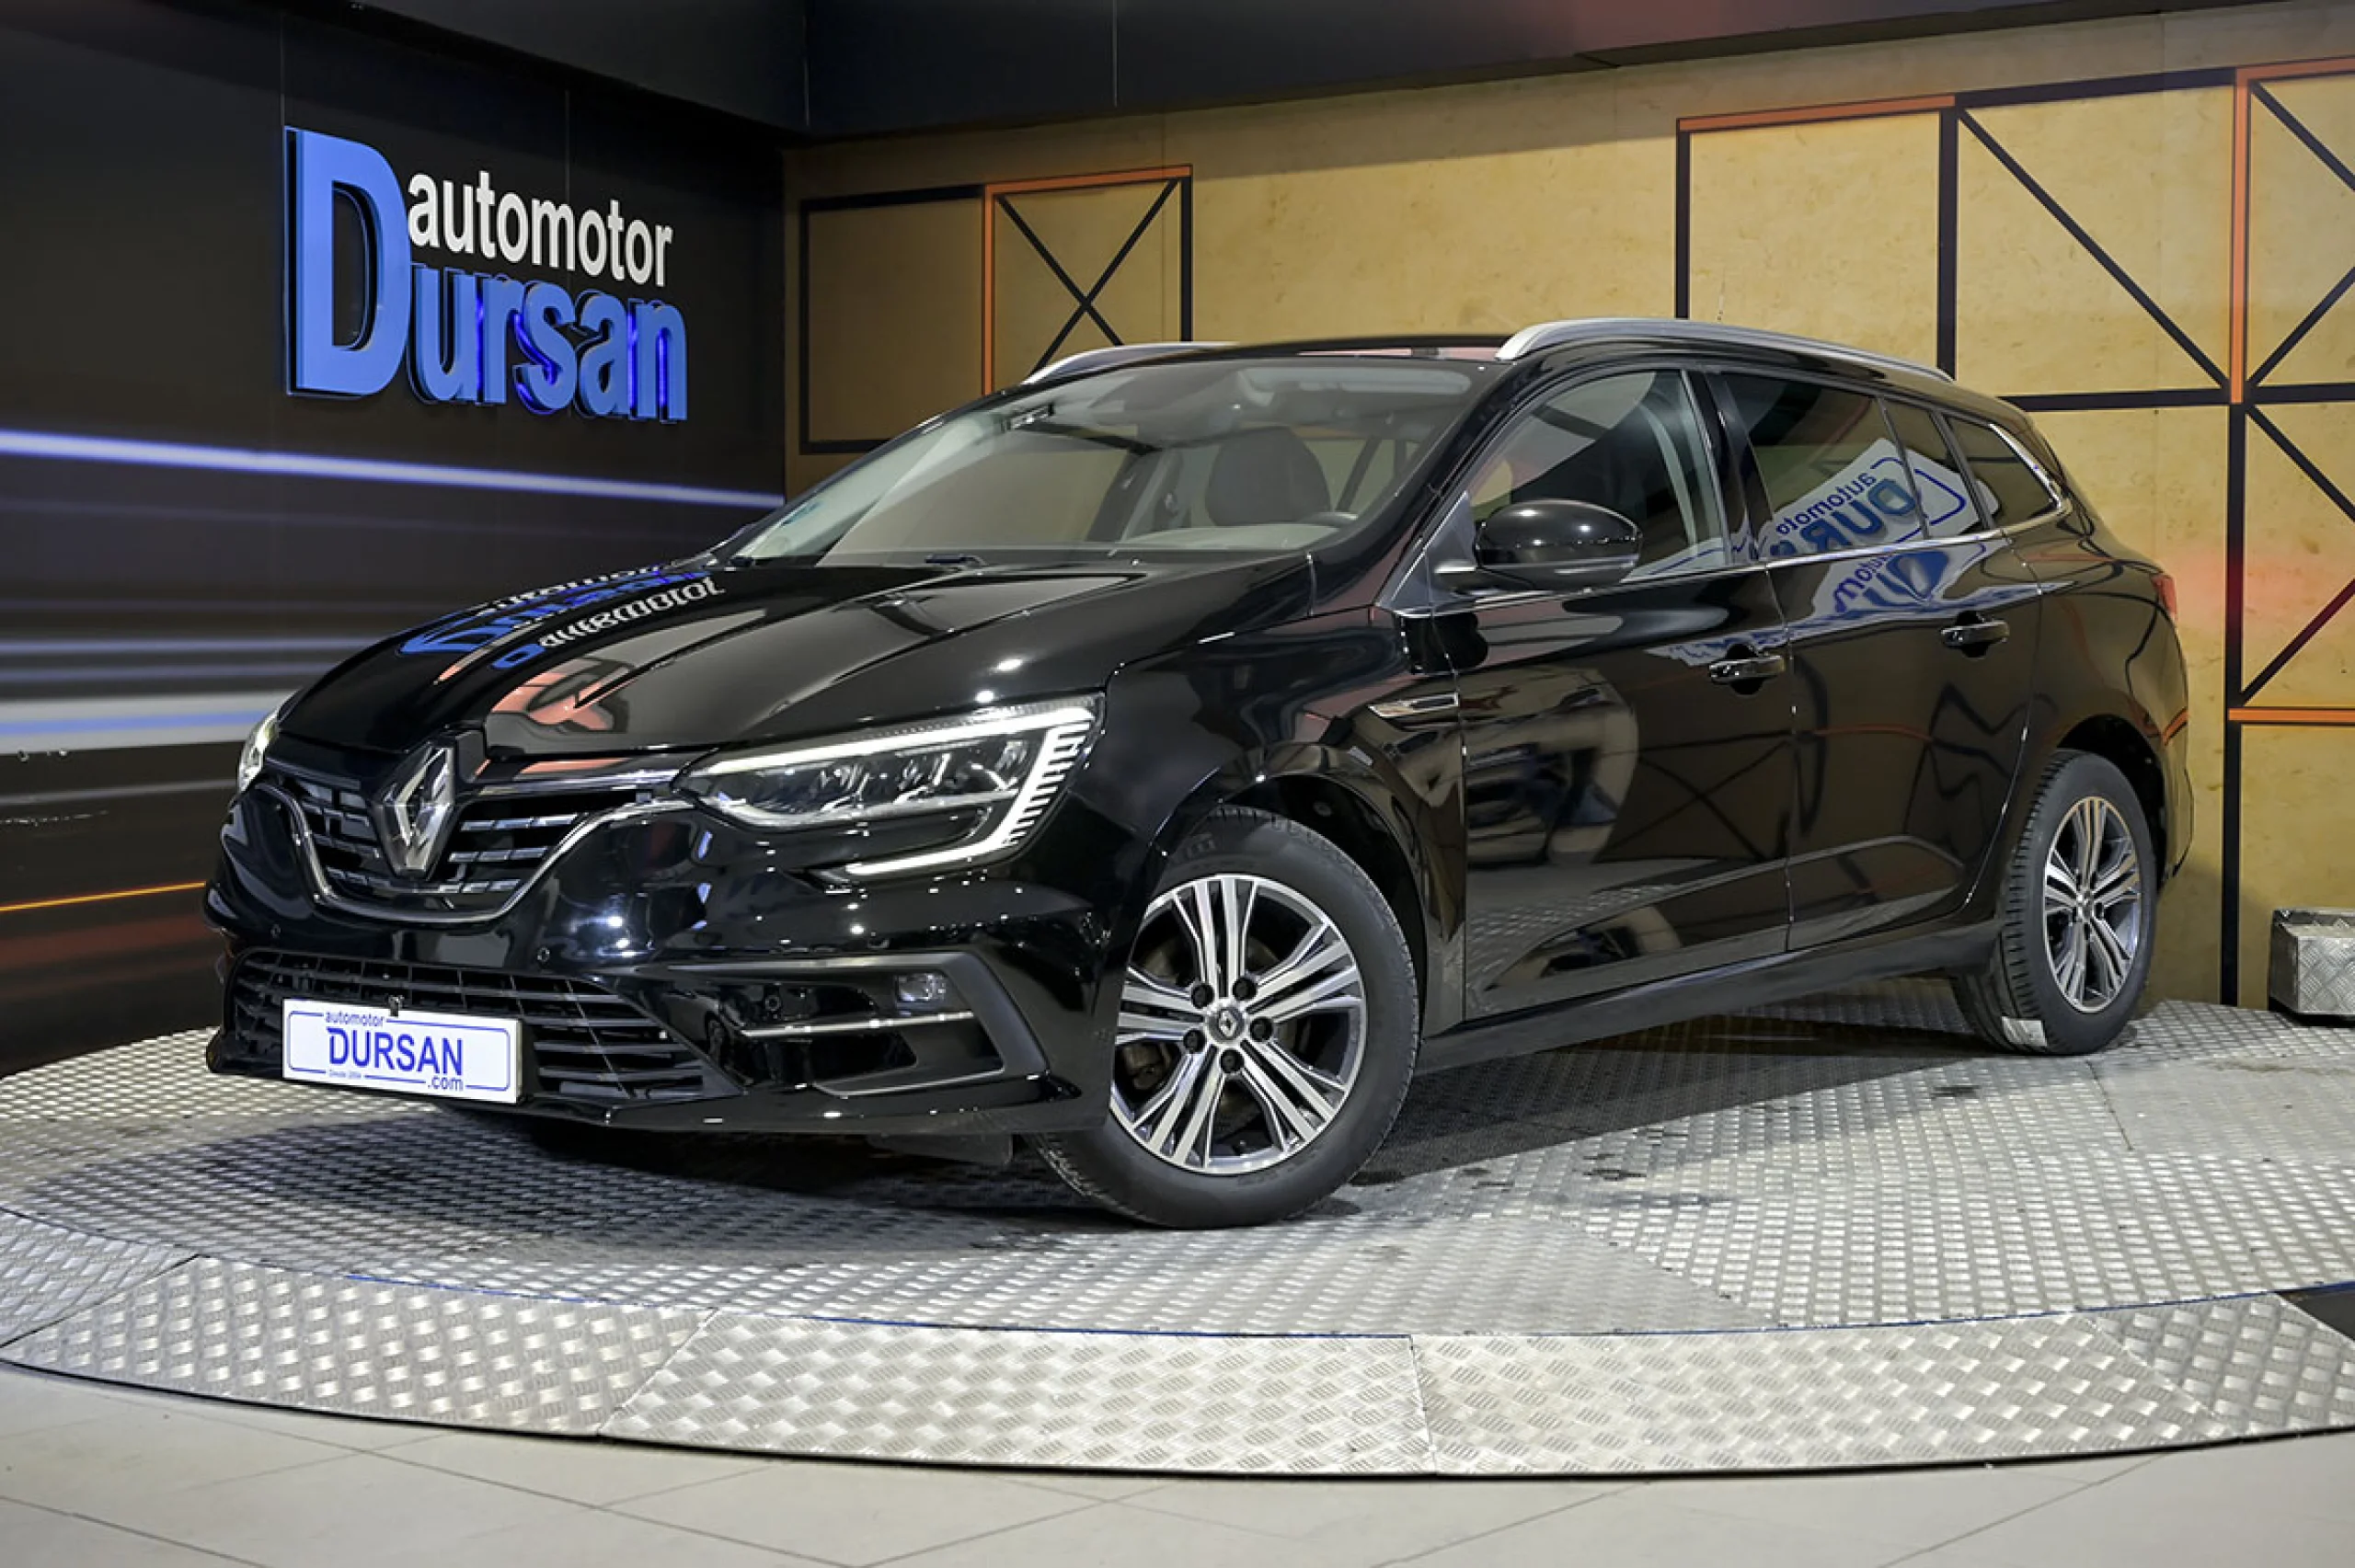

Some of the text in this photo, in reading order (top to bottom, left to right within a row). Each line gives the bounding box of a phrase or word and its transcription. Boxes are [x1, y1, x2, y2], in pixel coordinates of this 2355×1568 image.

[407, 170, 672, 286] automotor
[284, 125, 687, 421] Dursan
[325, 1011, 385, 1027] automotor
[326, 1026, 463, 1076] DURSAN
[428, 1076, 464, 1092] .com
